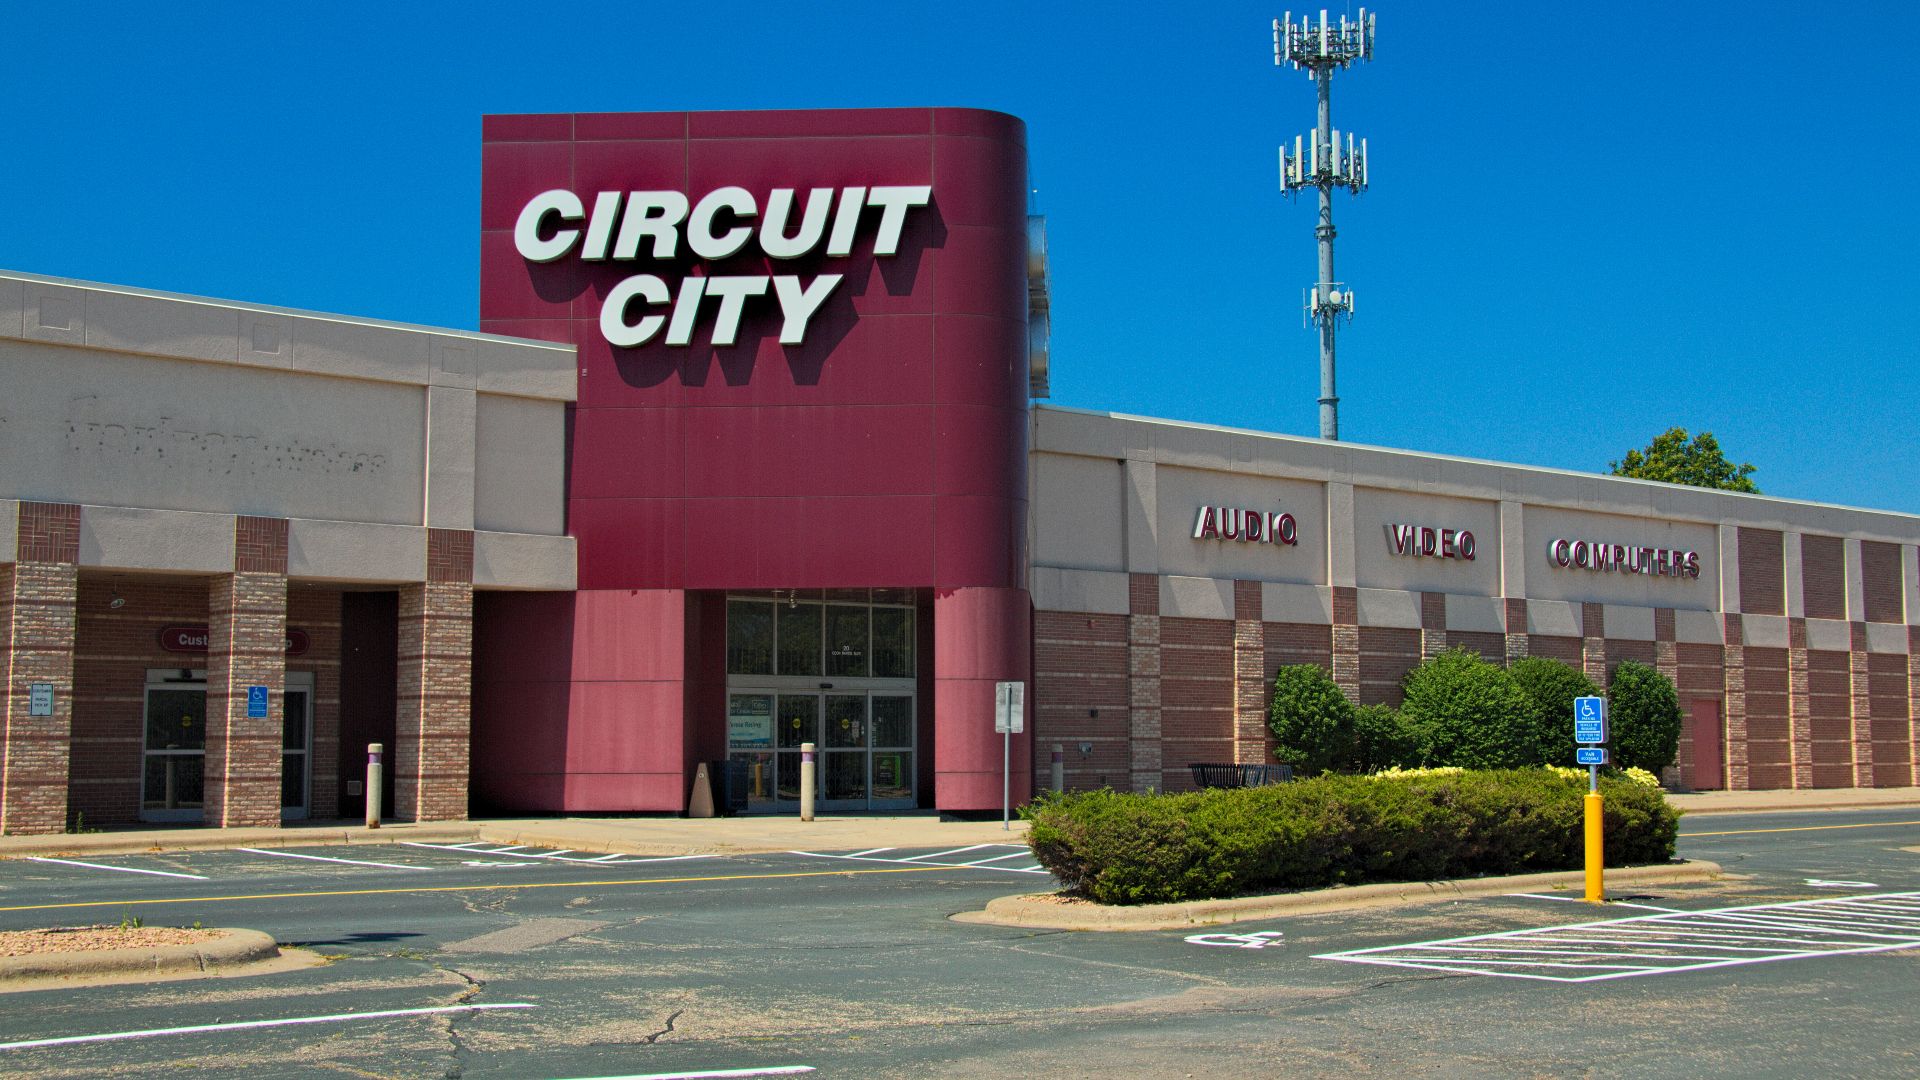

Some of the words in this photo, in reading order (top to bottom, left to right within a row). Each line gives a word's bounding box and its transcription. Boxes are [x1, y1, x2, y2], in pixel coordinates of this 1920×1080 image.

[514, 185, 932, 263] CIRCUIT
[599, 274, 844, 348] CITY
[1197, 505, 1298, 546] AUDIO
[1385, 523, 1476, 561] VIDEO
[1549, 539, 1701, 579] COMPUTERS
